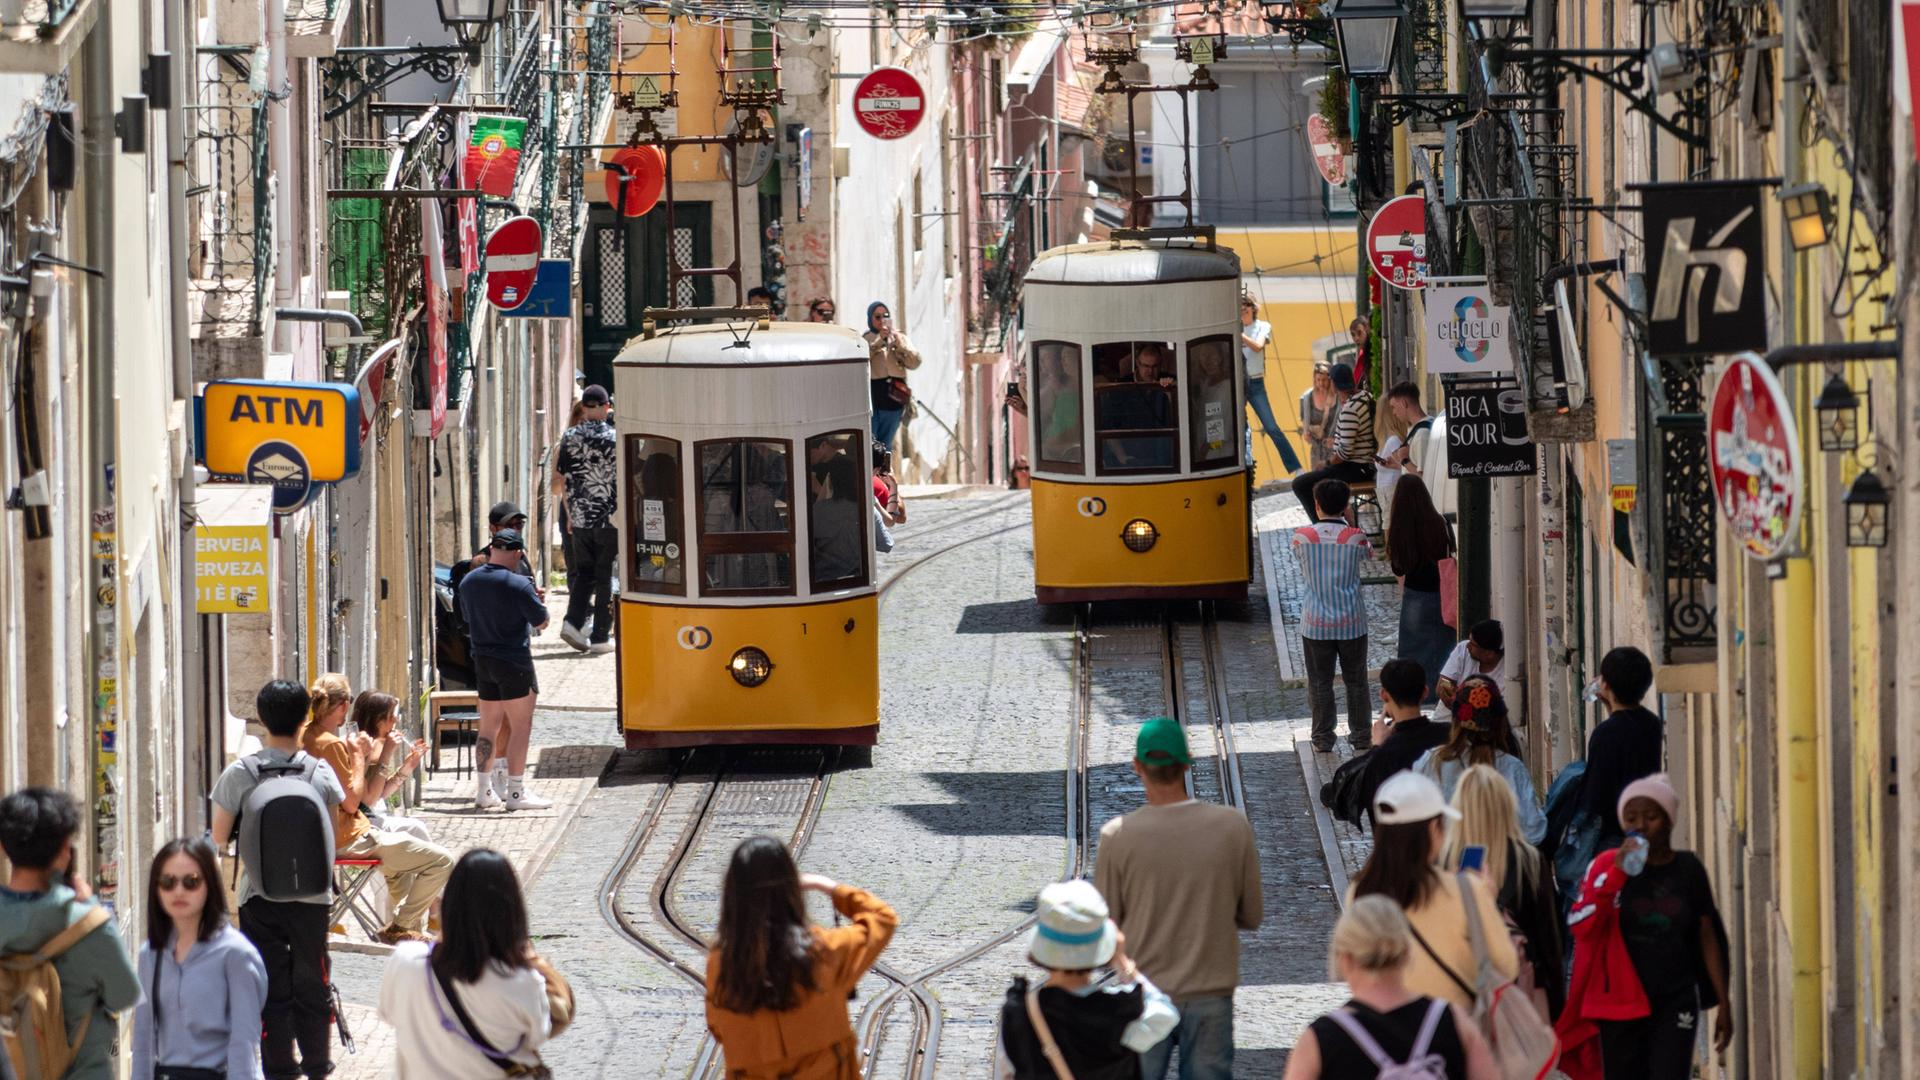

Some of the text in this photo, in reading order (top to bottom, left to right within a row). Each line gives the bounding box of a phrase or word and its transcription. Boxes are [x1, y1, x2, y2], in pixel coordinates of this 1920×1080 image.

[1438, 319, 1502, 340] CHOCLO
[229, 394, 324, 428] ATM
[1449, 395, 1490, 419] BICA
[1450, 423, 1498, 446] SOUR
[262, 460, 296, 473] Euronet
[1451, 459, 1532, 476] Tapas & Cocktail Bar
[1614, 489, 1634, 499] MINI
[1184, 498, 1191, 508] 2
[194, 537, 262, 552] ERVEJA
[194, 561, 265, 576] ERVEZA
[802, 623, 807, 635] 1
